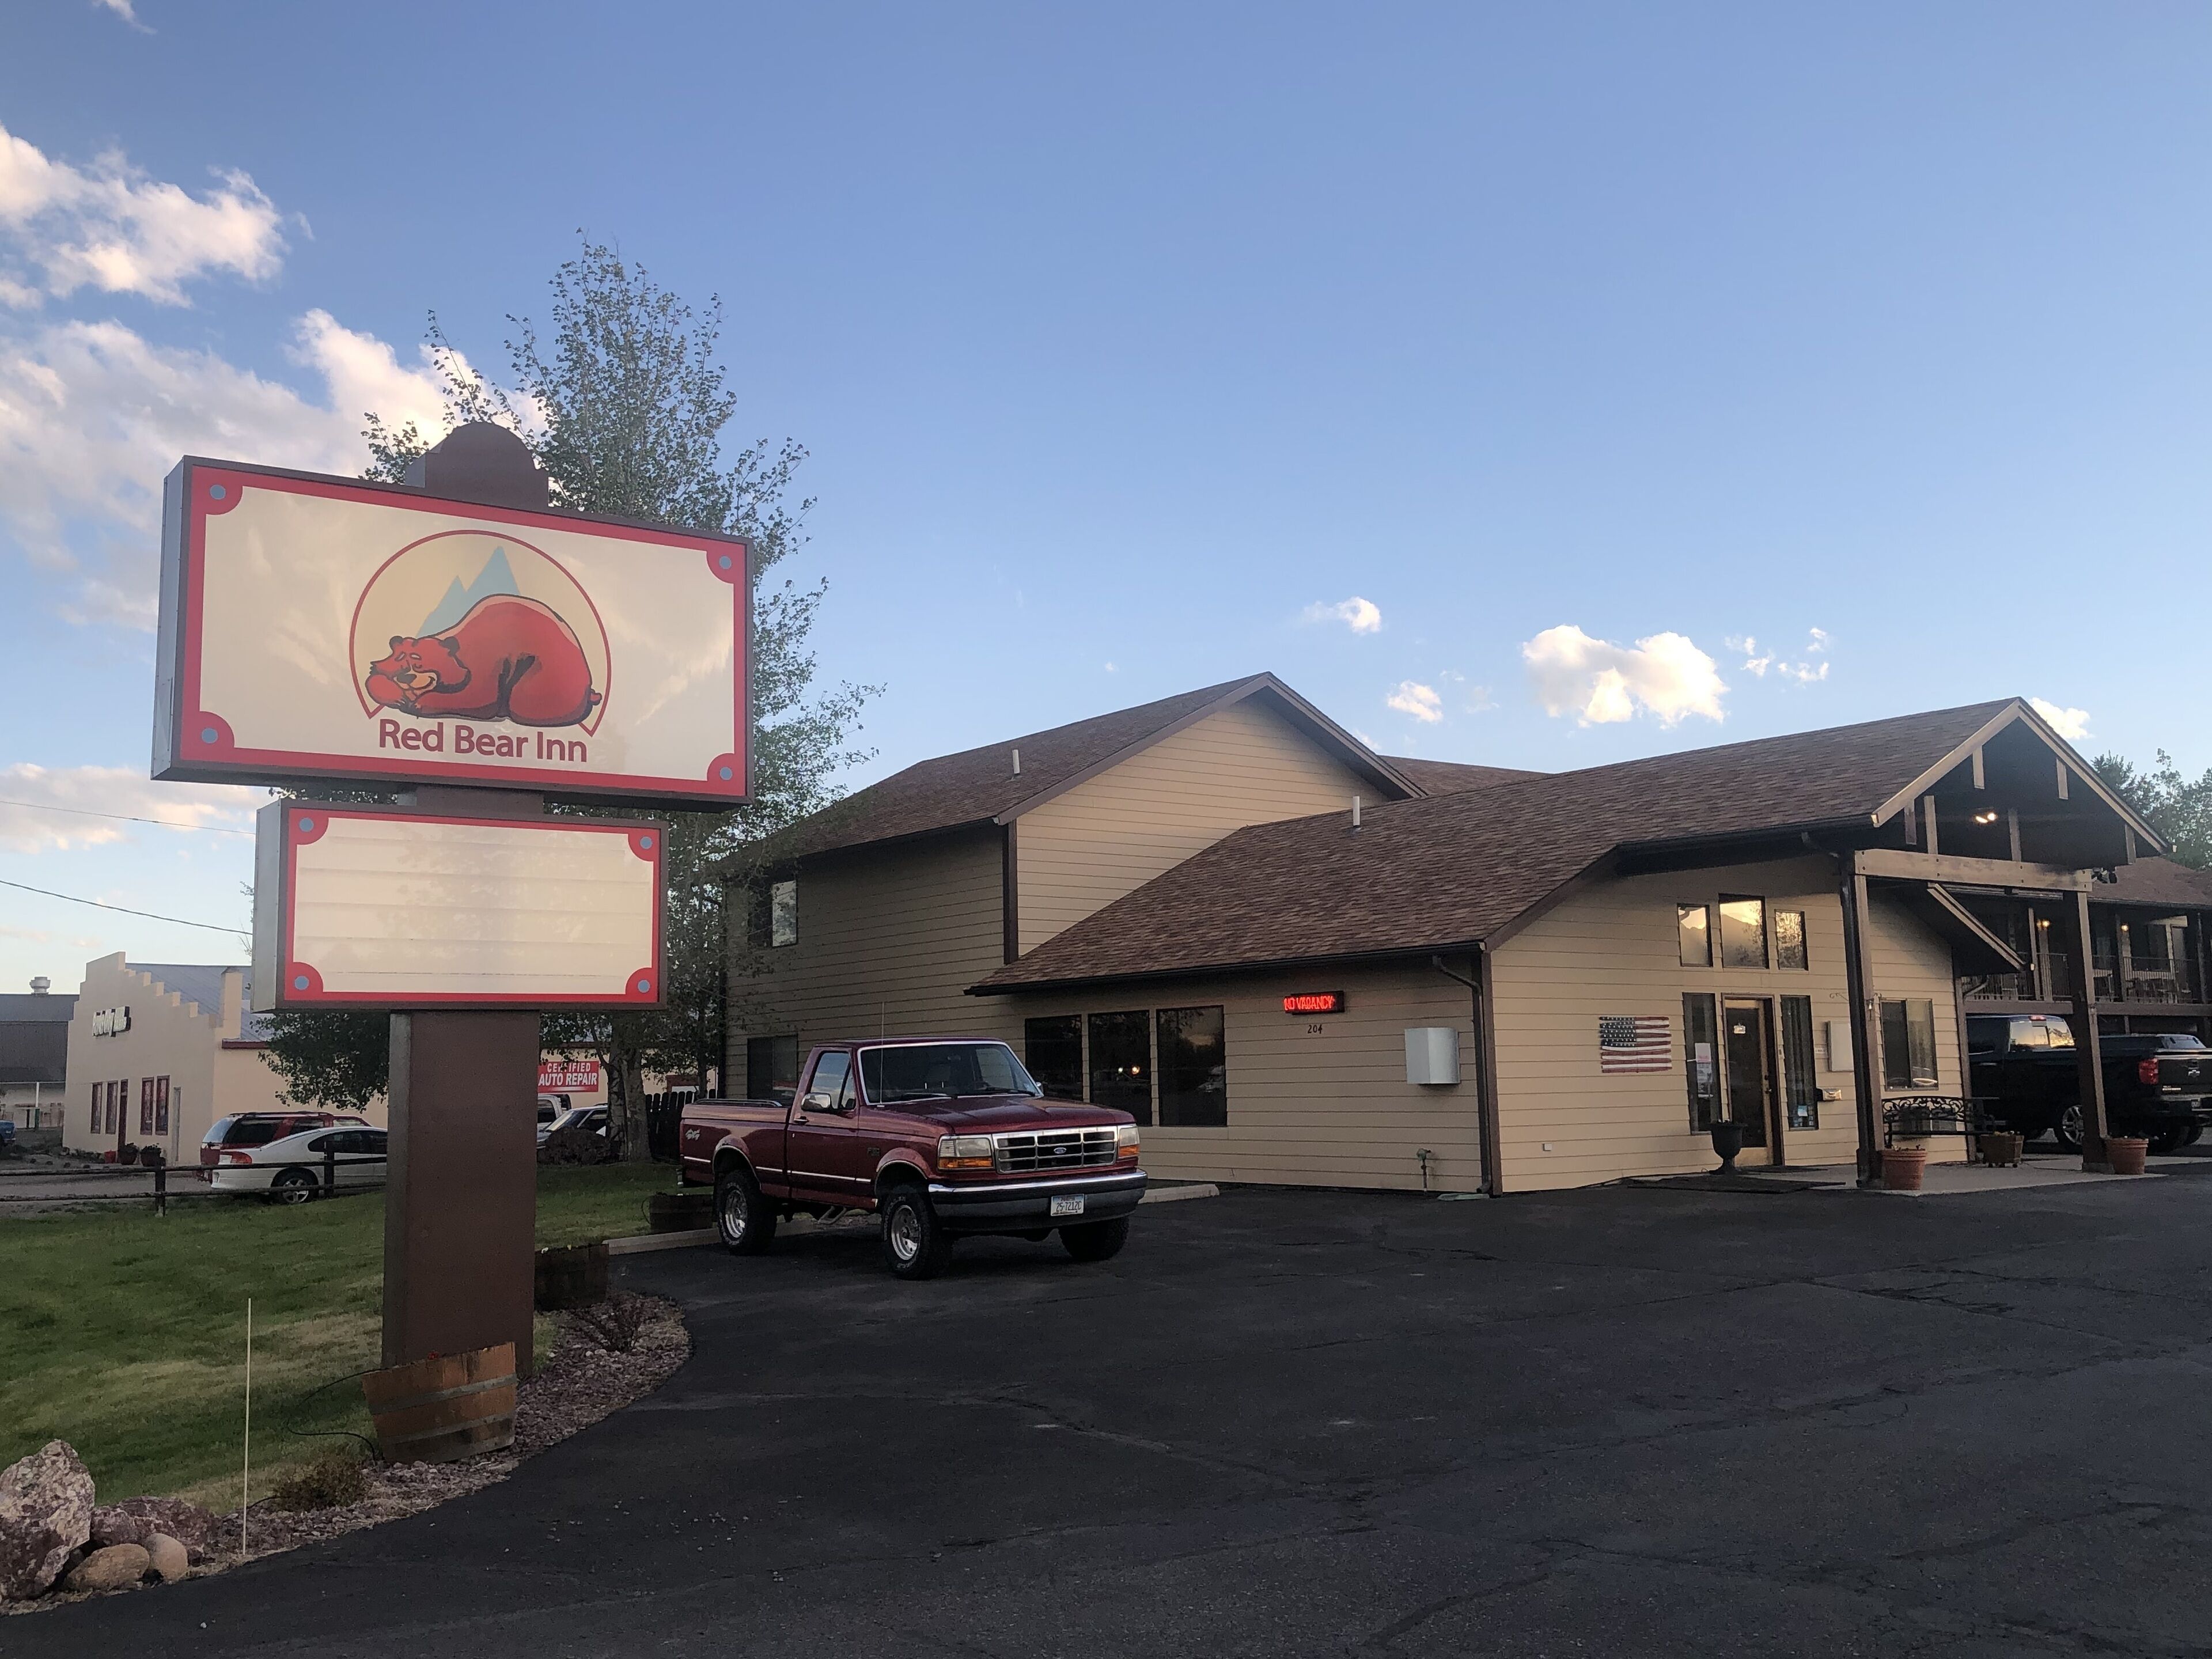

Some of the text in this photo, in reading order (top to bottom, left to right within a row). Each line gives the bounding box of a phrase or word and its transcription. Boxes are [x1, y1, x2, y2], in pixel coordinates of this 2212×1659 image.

[379, 718, 588, 763] Red Bear Inn
[1283, 998, 1296, 1011] NO
[1307, 1024, 1323, 1035] 204
[537, 1073, 597, 1086] AUTO REPAIR
